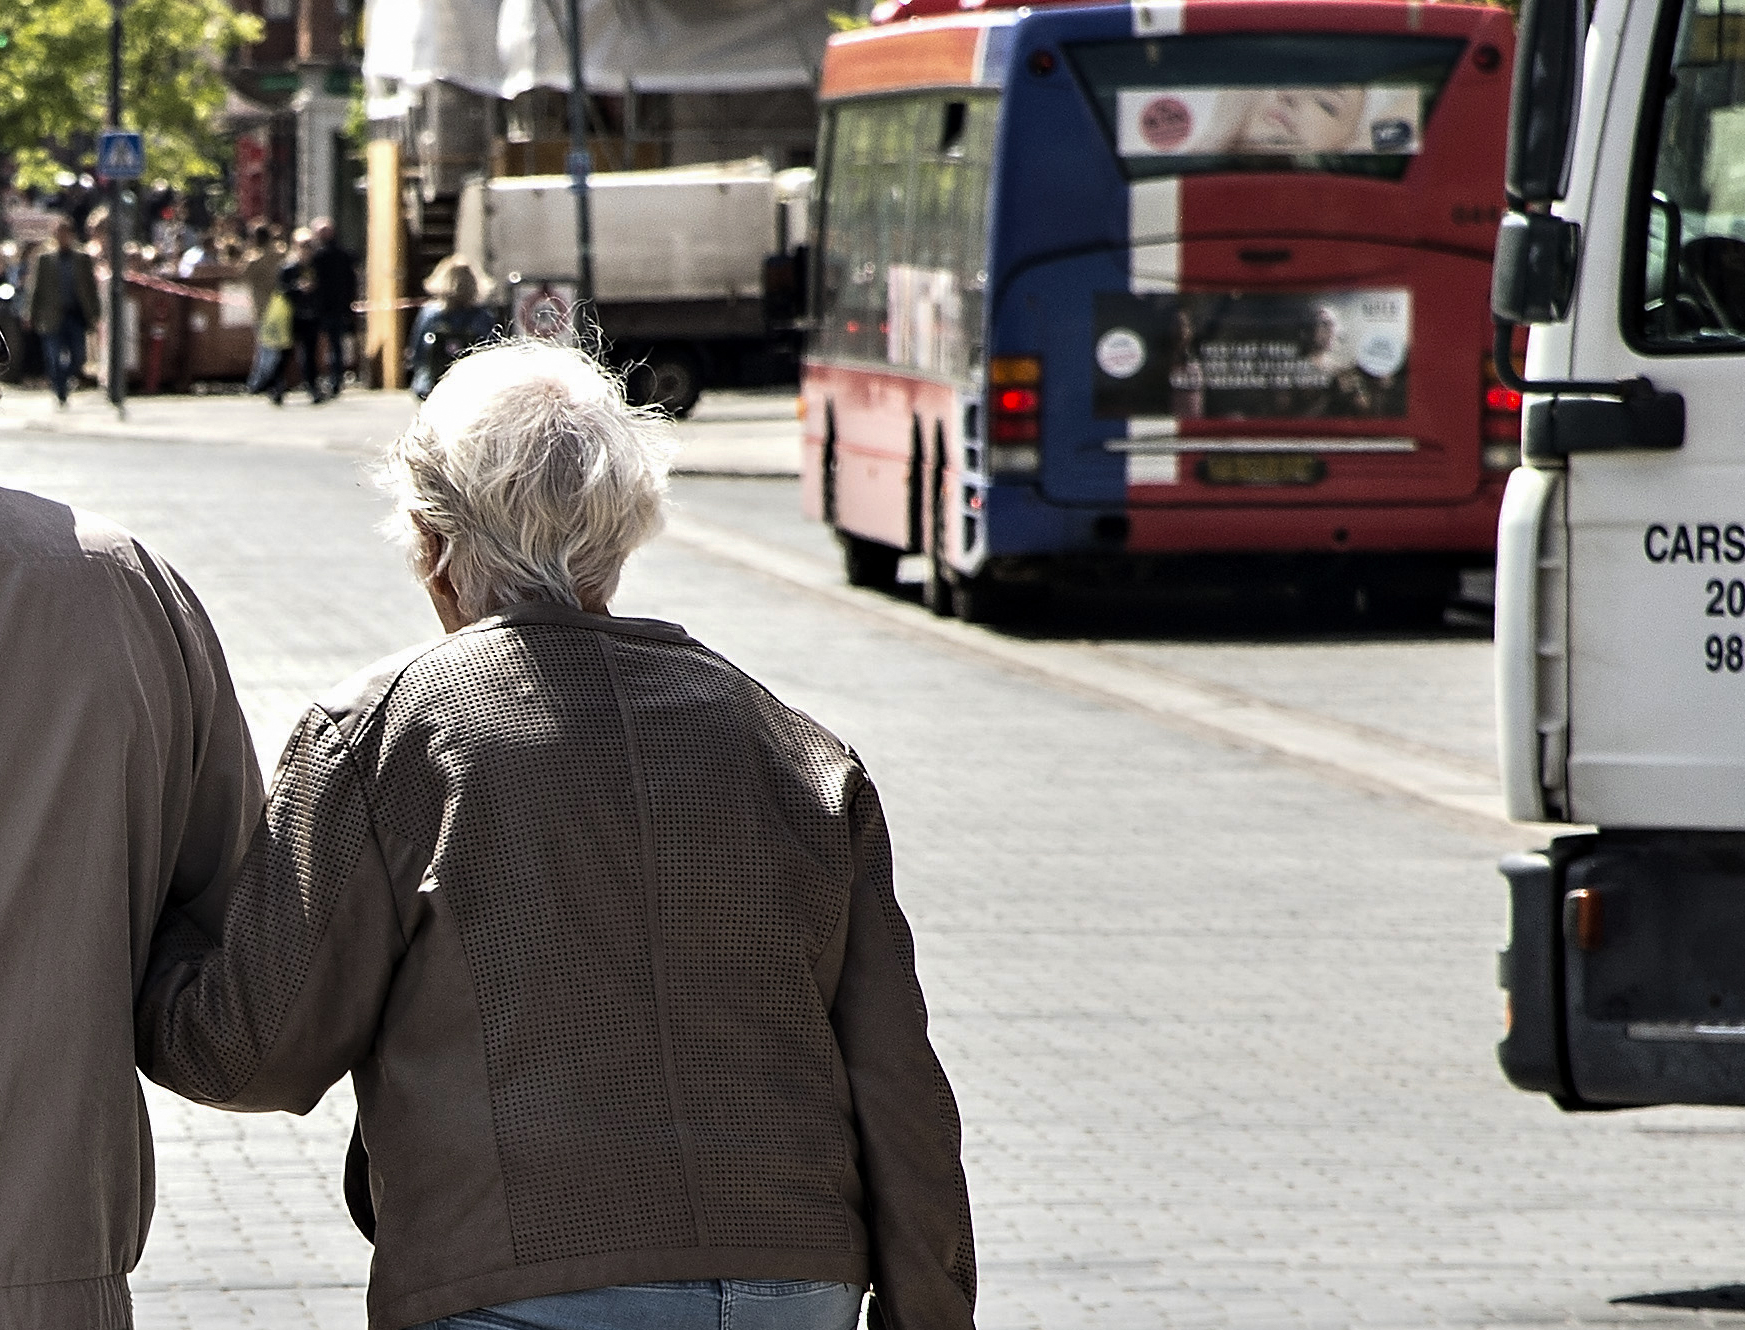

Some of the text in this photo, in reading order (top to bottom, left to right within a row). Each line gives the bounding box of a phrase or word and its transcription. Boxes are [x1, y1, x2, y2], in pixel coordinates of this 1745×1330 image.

[1644, 523, 1745, 564] CARS
[1706, 579, 1745, 617] 20
[1706, 634, 1743, 673] 98
